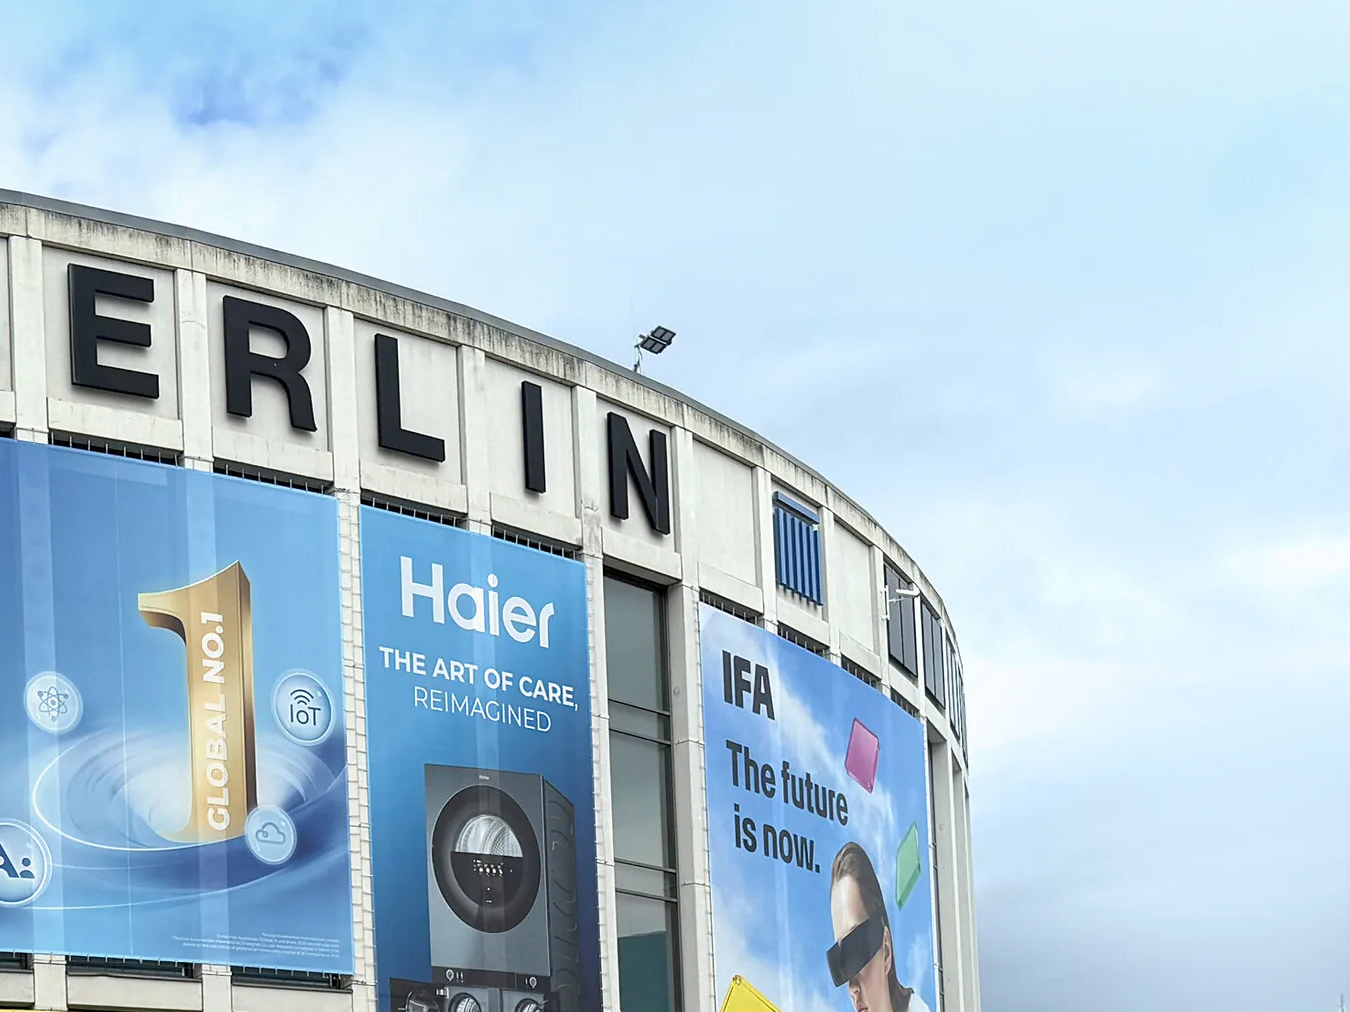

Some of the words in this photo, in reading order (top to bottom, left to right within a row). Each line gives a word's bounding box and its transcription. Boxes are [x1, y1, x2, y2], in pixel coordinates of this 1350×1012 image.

[400, 556, 555, 648] Haier
[200, 611, 225, 684] NO.1
[379, 646, 426, 675] THE
[432, 657, 478, 685] ART
[484, 668, 513, 692] OF
[519, 676, 578, 711] CARE,
[413, 686, 551, 732] REIMAGINED
[722, 649, 775, 720] IFA
[204, 694, 230, 831] GLOBAL
[726, 739, 776, 799] The
[781, 760, 849, 826] future
[733, 803, 757, 853] is
[763, 823, 820, 874] now.
